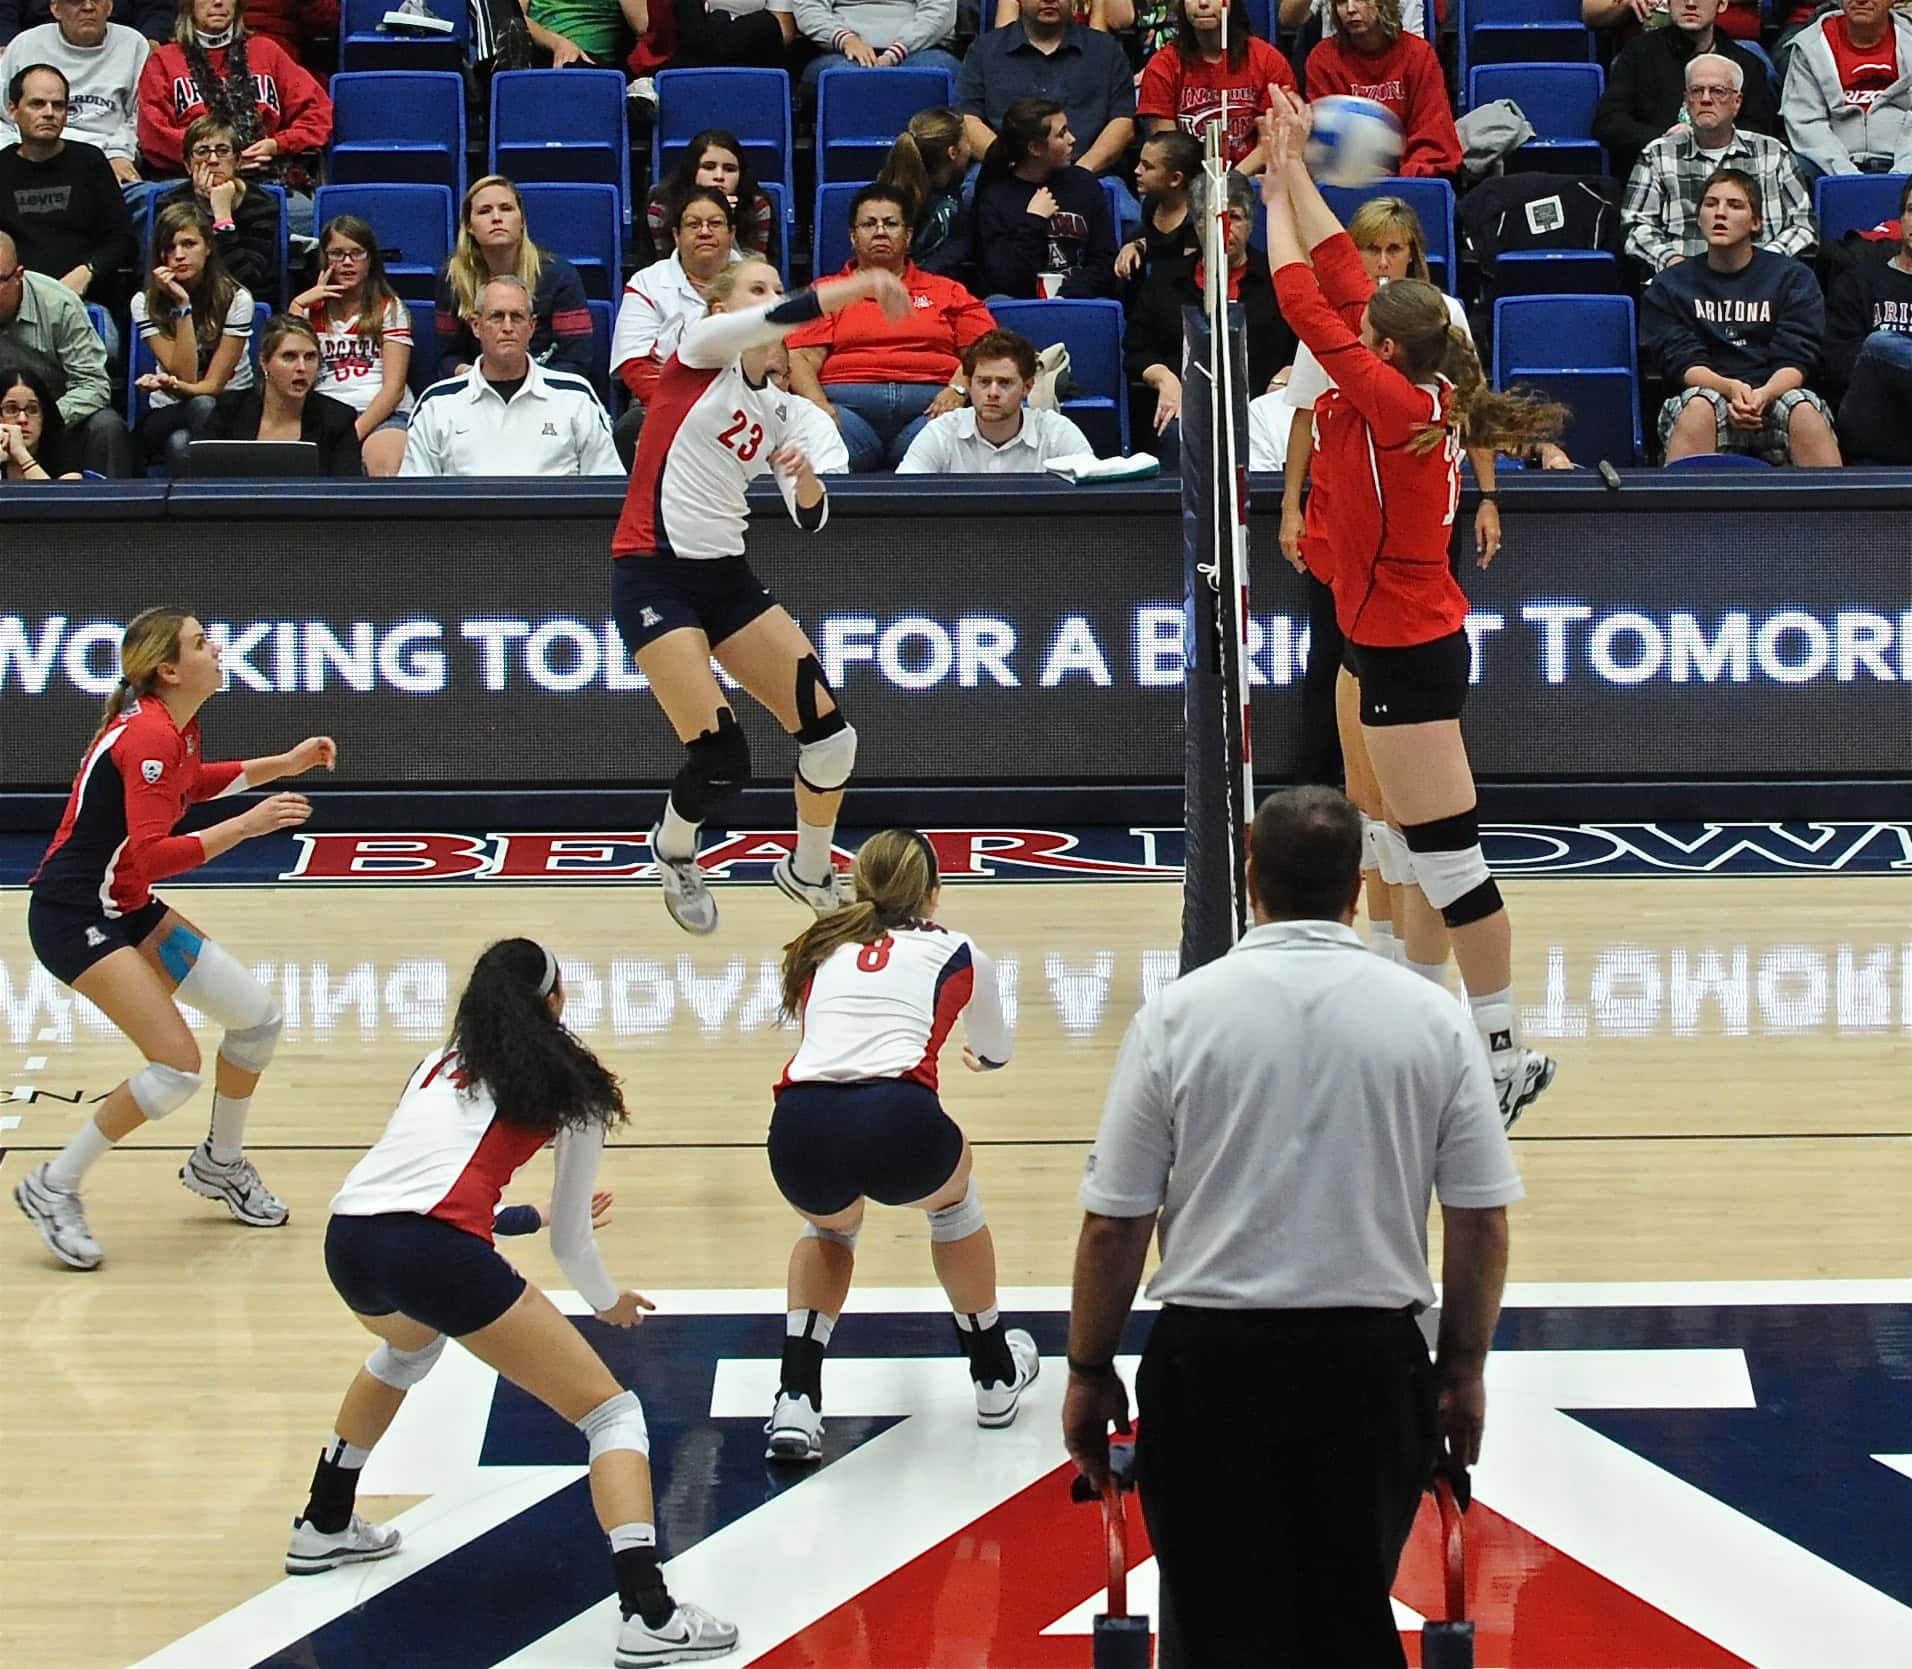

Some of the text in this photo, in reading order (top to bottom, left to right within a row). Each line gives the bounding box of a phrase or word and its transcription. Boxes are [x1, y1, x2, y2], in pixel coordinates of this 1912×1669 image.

[1694, 299, 1771, 322] ARIZONA
[1873, 301, 1912, 327] ARI
[717, 408, 764, 462] 23
[0, 610, 448, 694] WOKING
[821, 616, 1021, 688] FOR
[1039, 617, 1113, 687] A
[1521, 604, 1912, 684] TOMOR
[856, 934, 895, 973] 8
